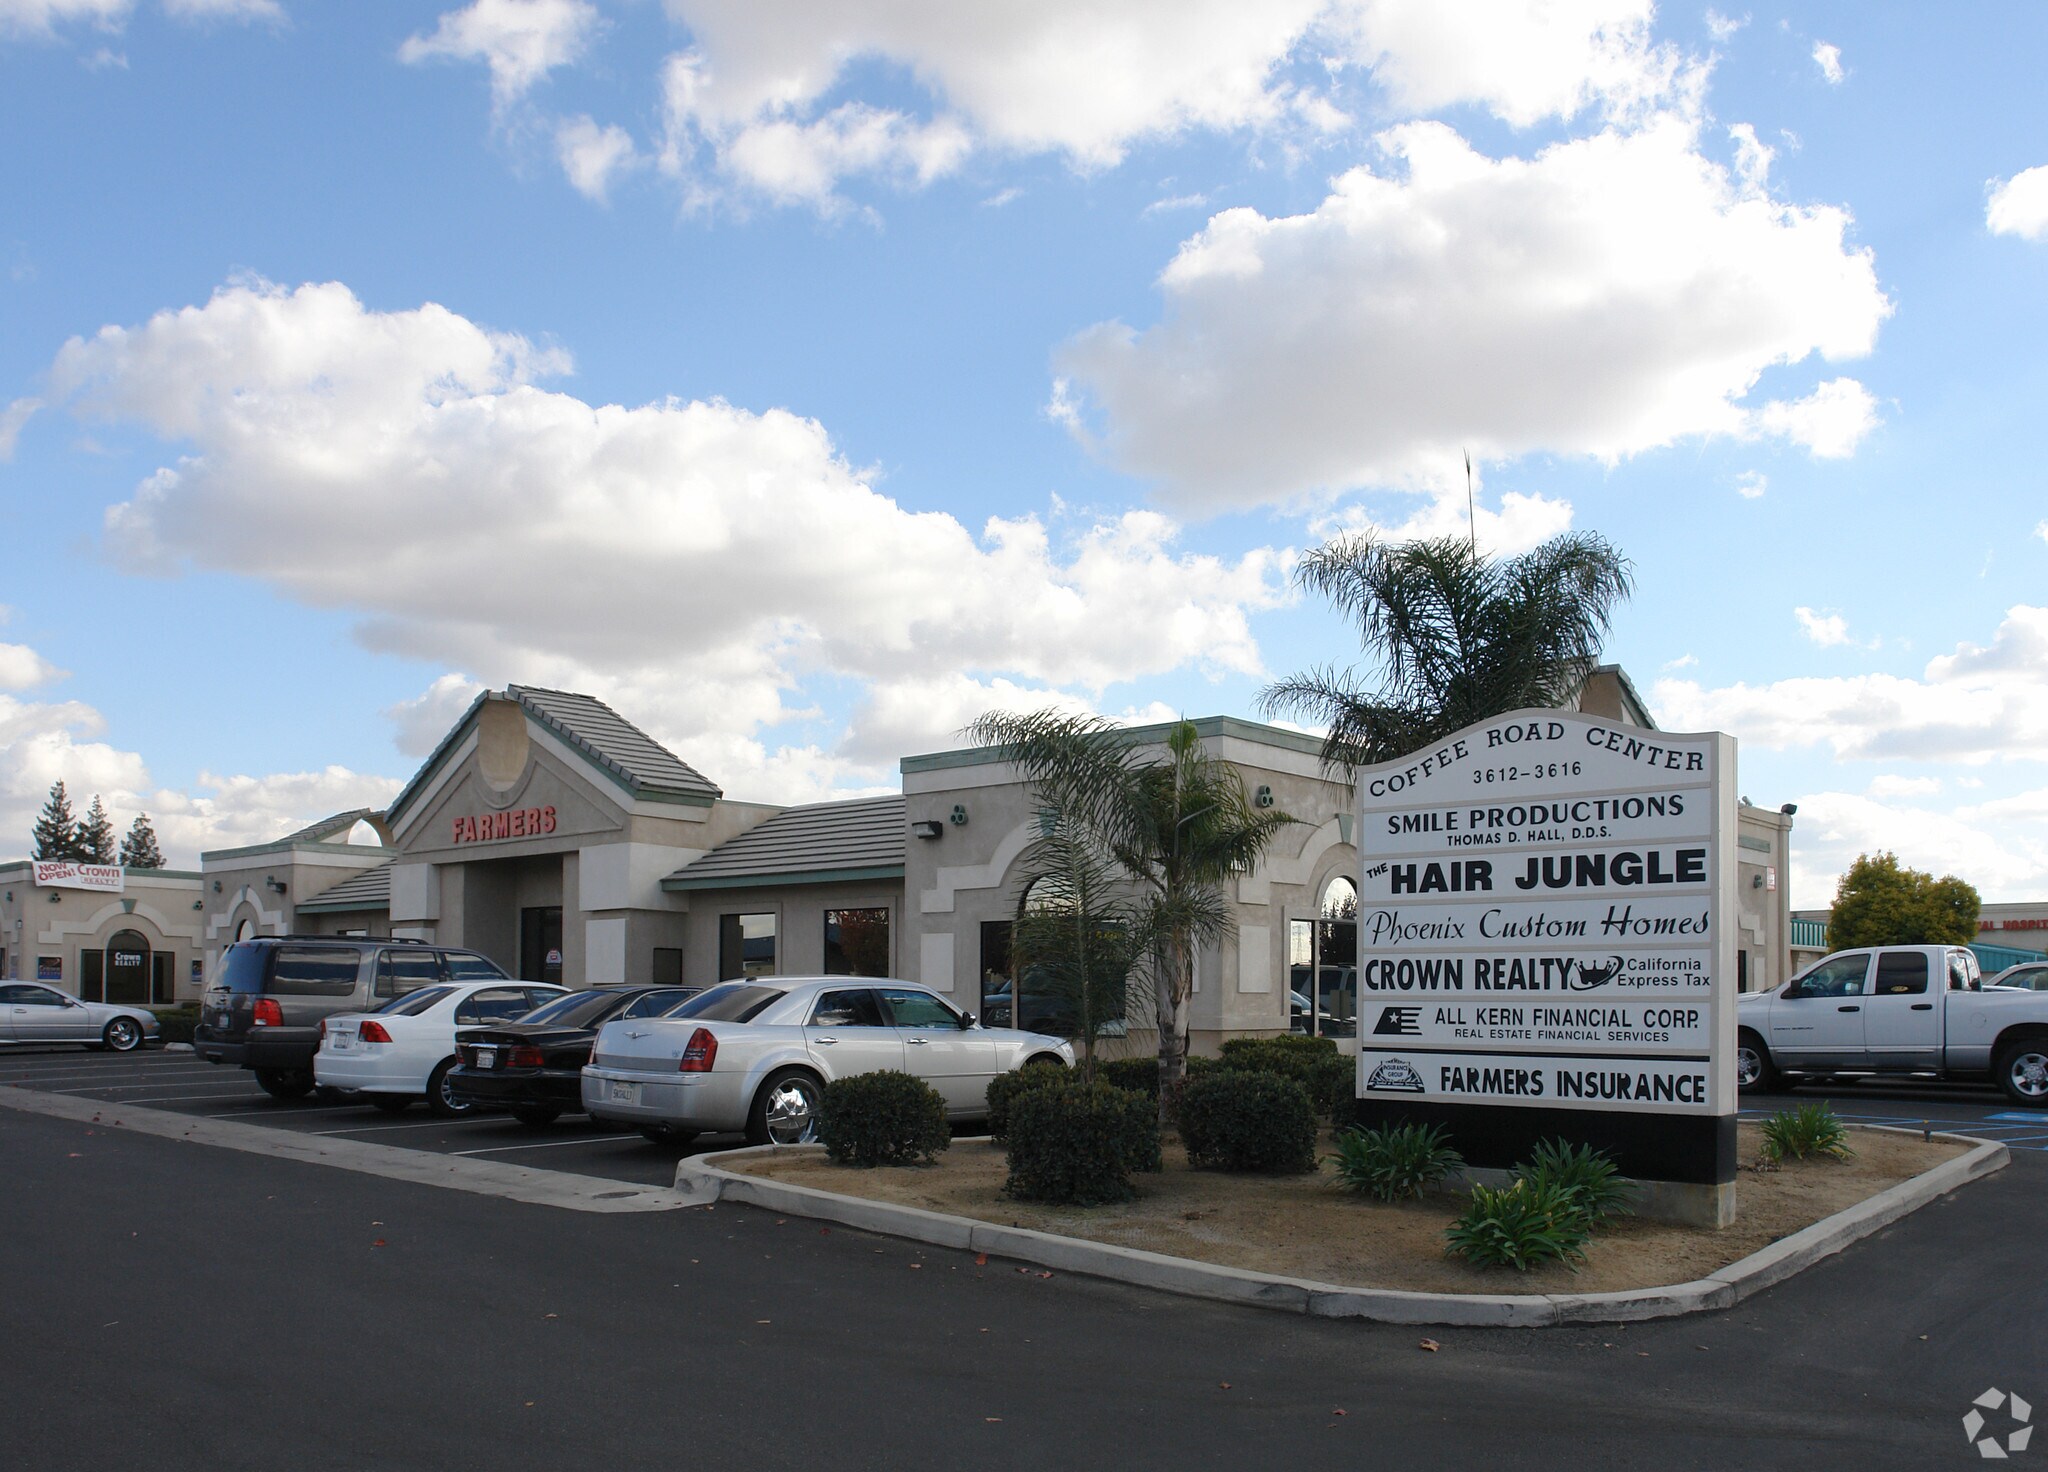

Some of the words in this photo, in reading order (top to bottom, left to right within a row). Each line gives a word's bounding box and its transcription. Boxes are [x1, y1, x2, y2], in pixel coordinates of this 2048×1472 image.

[1369, 740, 1469, 798] COFFEE
[1486, 722, 1565, 748] ROAD
[1586, 727, 1704, 771] CENTER
[1473, 761, 1582, 784] 3612-3616
[1388, 811, 1458, 834] SMILE
[1469, 794, 1684, 829] PRODUCTIONS
[452, 805, 557, 844] FARMERS
[1447, 832, 1501, 846] THOMAS
[1508, 831, 1521, 843] D.
[1527, 828, 1565, 842] HALL,
[1572, 826, 1612, 839] D.D.S.
[38, 862, 67, 873] NOW
[38, 868, 76, 881] OPEN!
[77, 863, 120, 877] Crown
[1366, 862, 1389, 879] THE
[1391, 860, 1493, 894] HAIR
[1515, 848, 1706, 890] JUNGLE
[1366, 910, 1465, 945] Phoenix
[1479, 909, 1587, 937] Custom
[1601, 905, 1709, 936] Homes
[115, 952, 141, 960] Crown
[1627, 957, 1701, 971] California
[1365, 959, 1464, 990] CROWN
[1475, 958, 1574, 990] REALTY
[1617, 974, 1679, 989] Express
[1684, 972, 1711, 986] Tax
[1435, 1008, 1466, 1025] ALL
[1476, 1008, 1523, 1026] KERN
[1533, 1009, 1632, 1027] FINANCIAL
[1643, 1009, 1699, 1028] CORP.
[1455, 1029, 1484, 1038] REAL
[1490, 1030, 1531, 1040] ESTATE
[1538, 1031, 1600, 1041] FINANCIAL
[1608, 1032, 1669, 1042] SERVICES
[1441, 1066, 1544, 1095] FARMERS
[1557, 1070, 1705, 1102] INSURANCE
